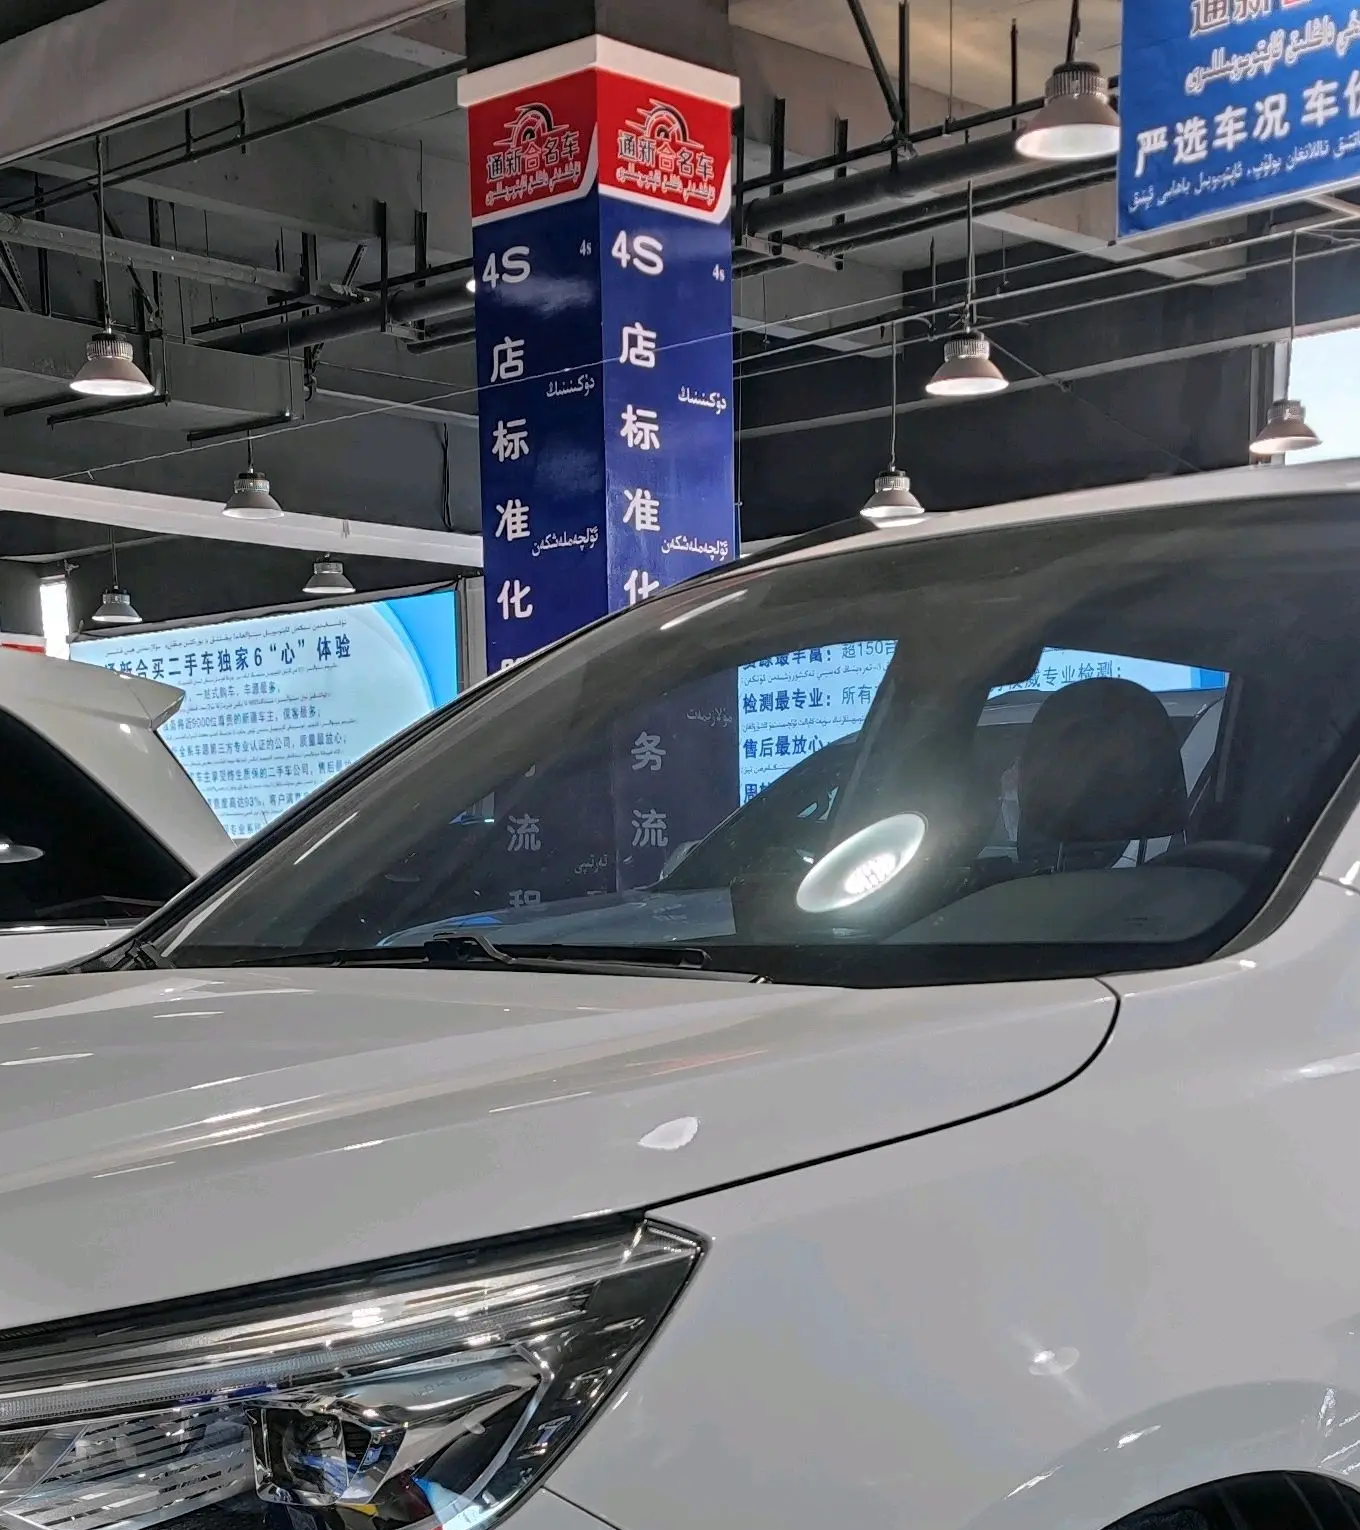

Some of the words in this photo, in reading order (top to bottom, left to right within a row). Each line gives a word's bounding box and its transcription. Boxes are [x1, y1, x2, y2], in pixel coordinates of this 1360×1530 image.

[487, 130, 579, 183] 通新合名车
[617, 129, 714, 181] 通新合名车
[1134, 93, 1290, 177] 严选车况
[579, 239, 593, 257] 4s
[712, 264, 725, 282] 4s
